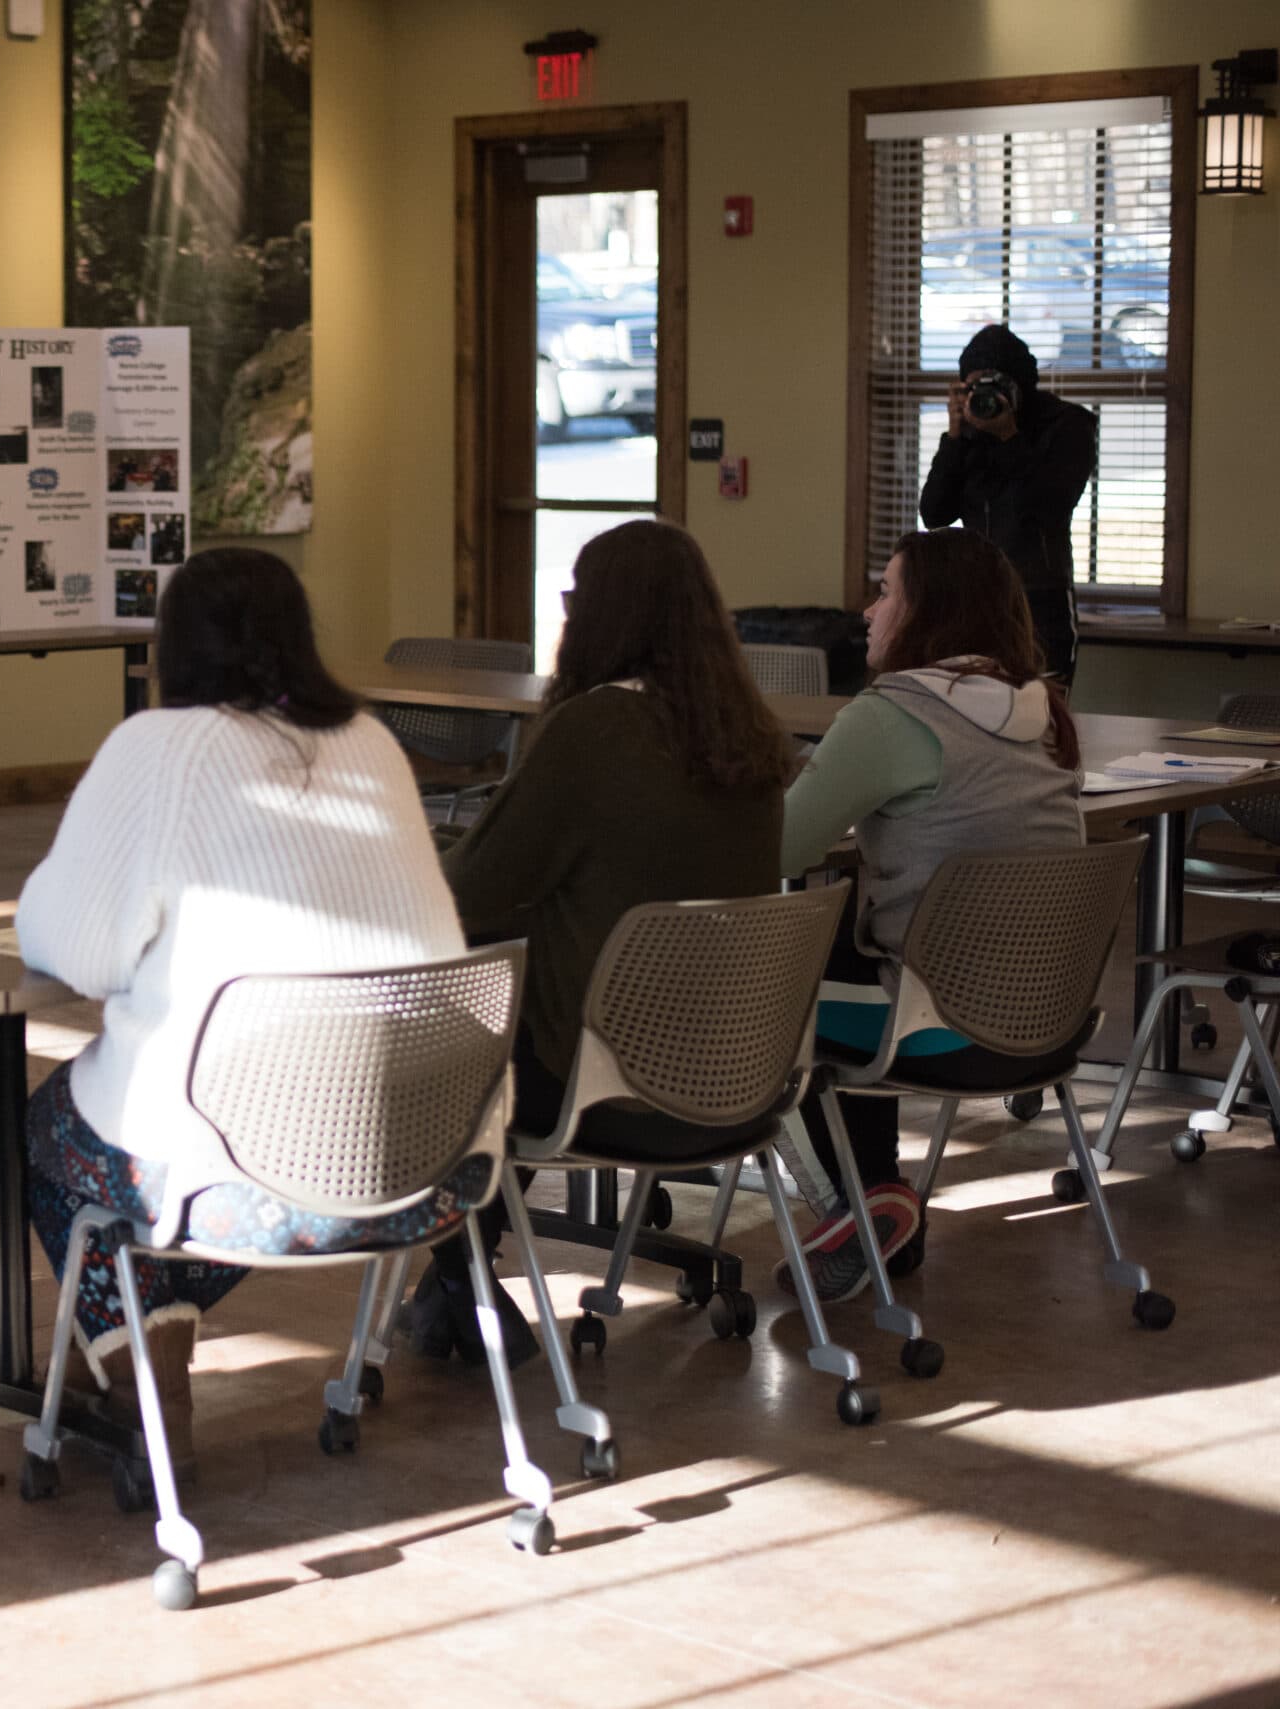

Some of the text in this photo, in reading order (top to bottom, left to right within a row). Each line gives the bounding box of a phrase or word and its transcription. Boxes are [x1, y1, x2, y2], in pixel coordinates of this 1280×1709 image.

[537, 52, 581, 100] EXIT
[10, 339, 75, 360] HISTORY
[690, 431, 721, 449] EXIT
